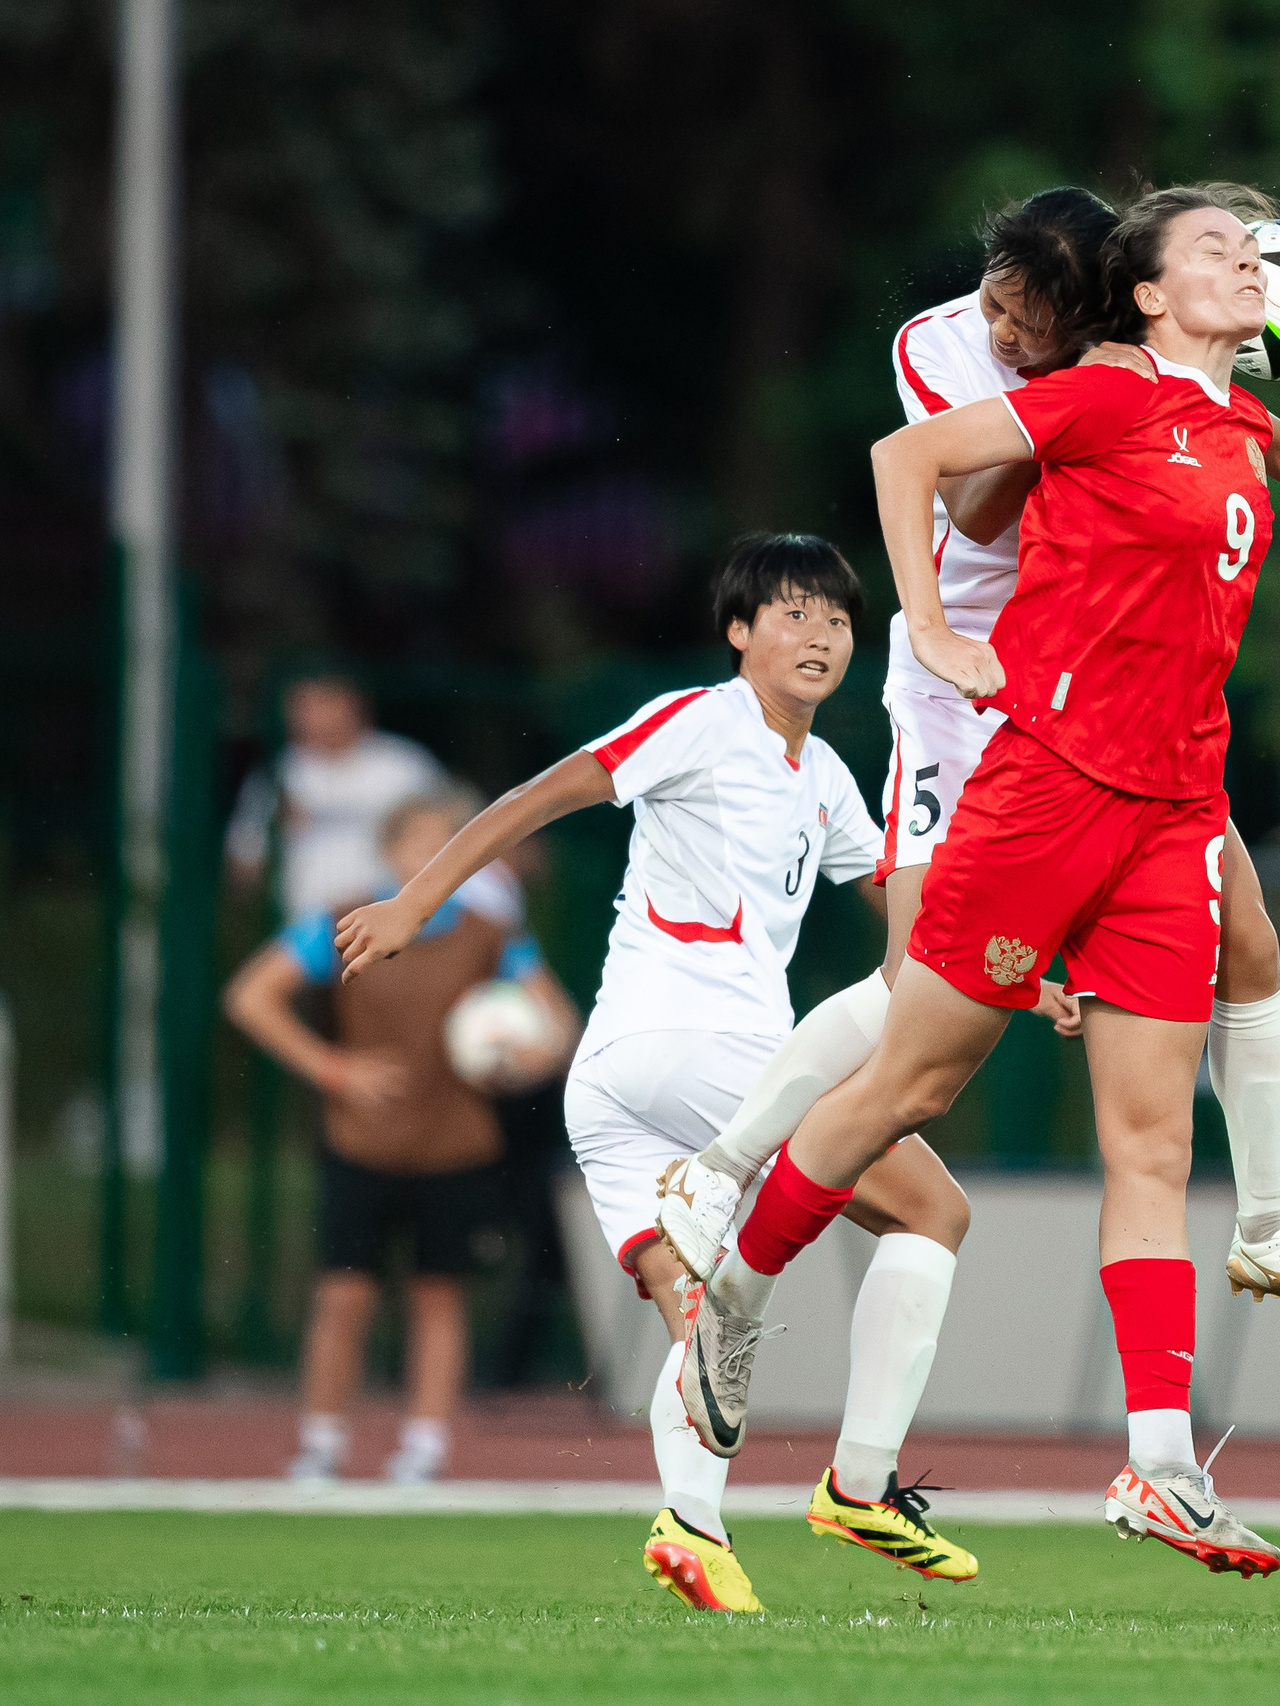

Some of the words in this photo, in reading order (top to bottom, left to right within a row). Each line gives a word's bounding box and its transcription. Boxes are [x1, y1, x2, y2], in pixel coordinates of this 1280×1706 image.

[1217, 492, 1256, 582] 9
[908, 762, 941, 837] 5
[785, 830, 810, 896] 3
